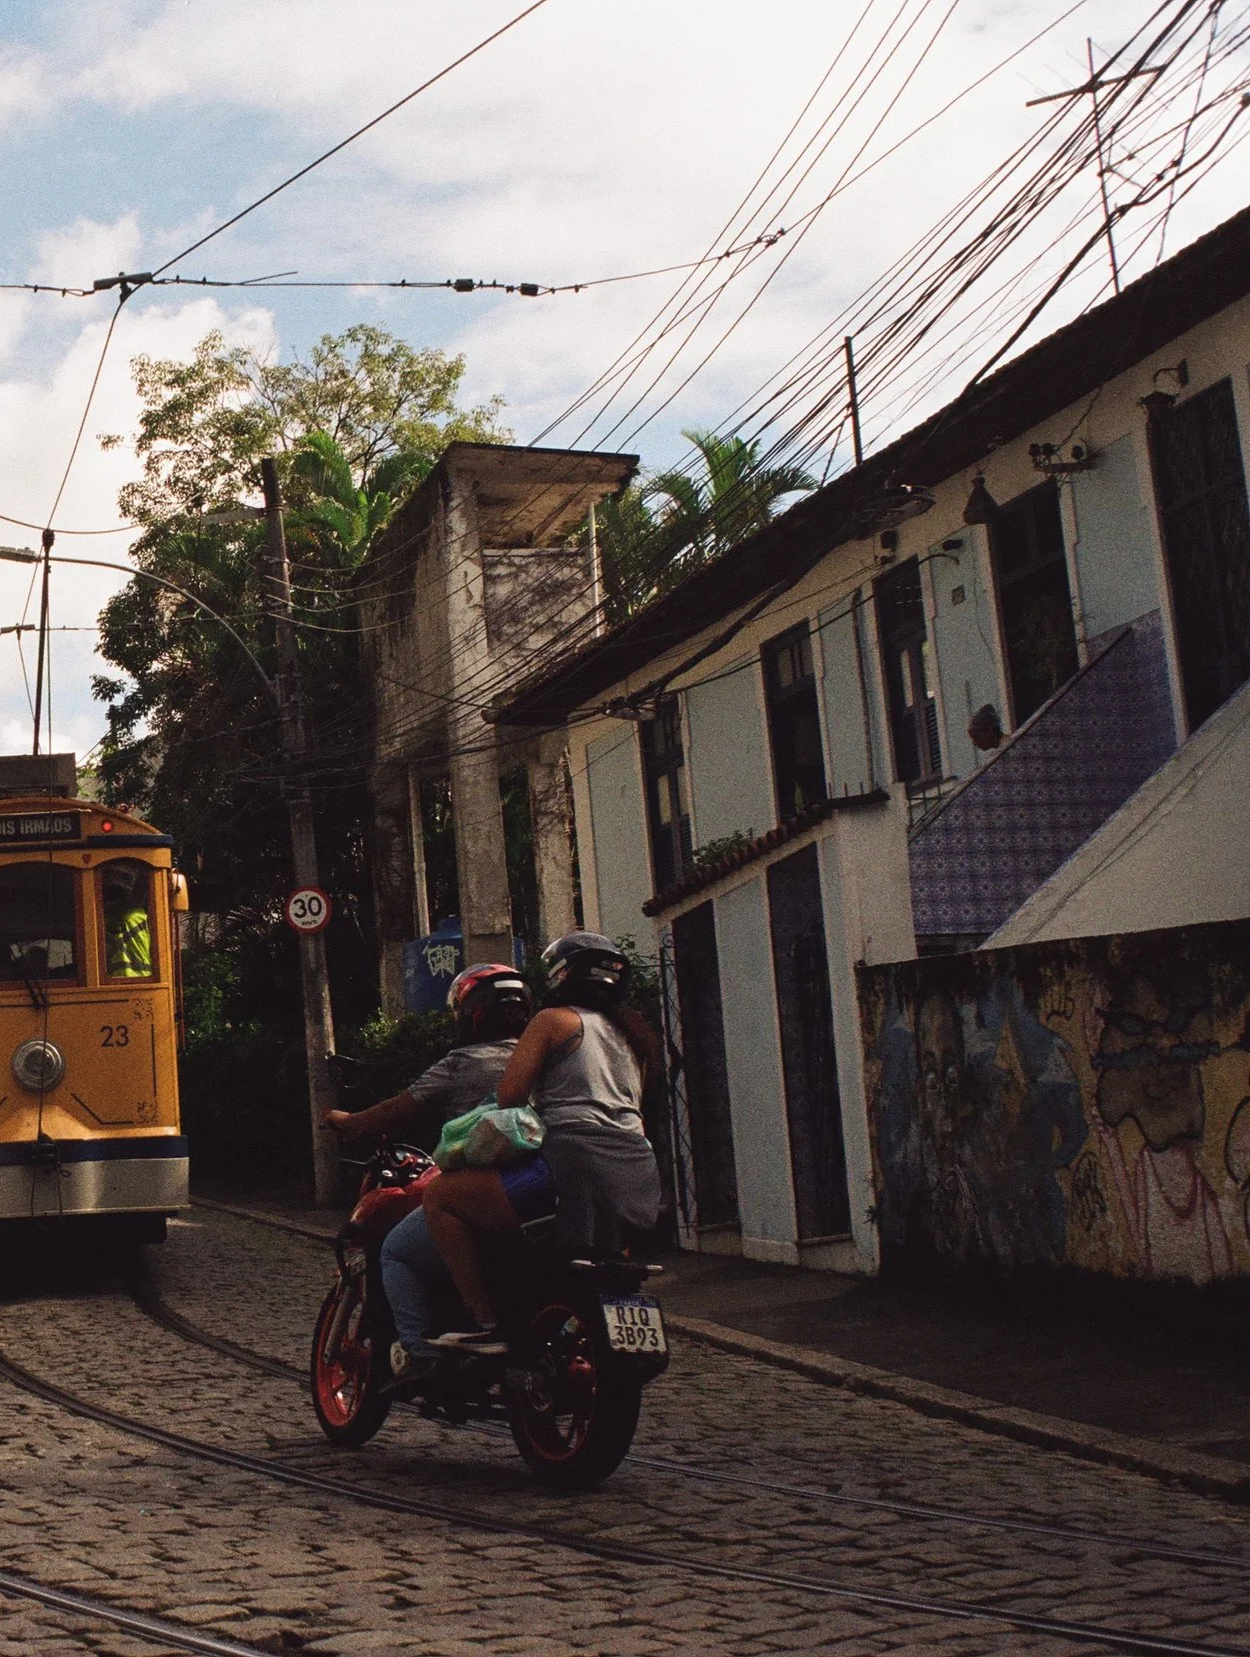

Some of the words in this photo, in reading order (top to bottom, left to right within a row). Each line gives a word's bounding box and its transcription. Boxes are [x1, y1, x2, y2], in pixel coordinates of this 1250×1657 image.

[293, 896, 322, 918] 30
[100, 1025, 130, 1048] 23
[614, 1325, 659, 1347] 3B93
